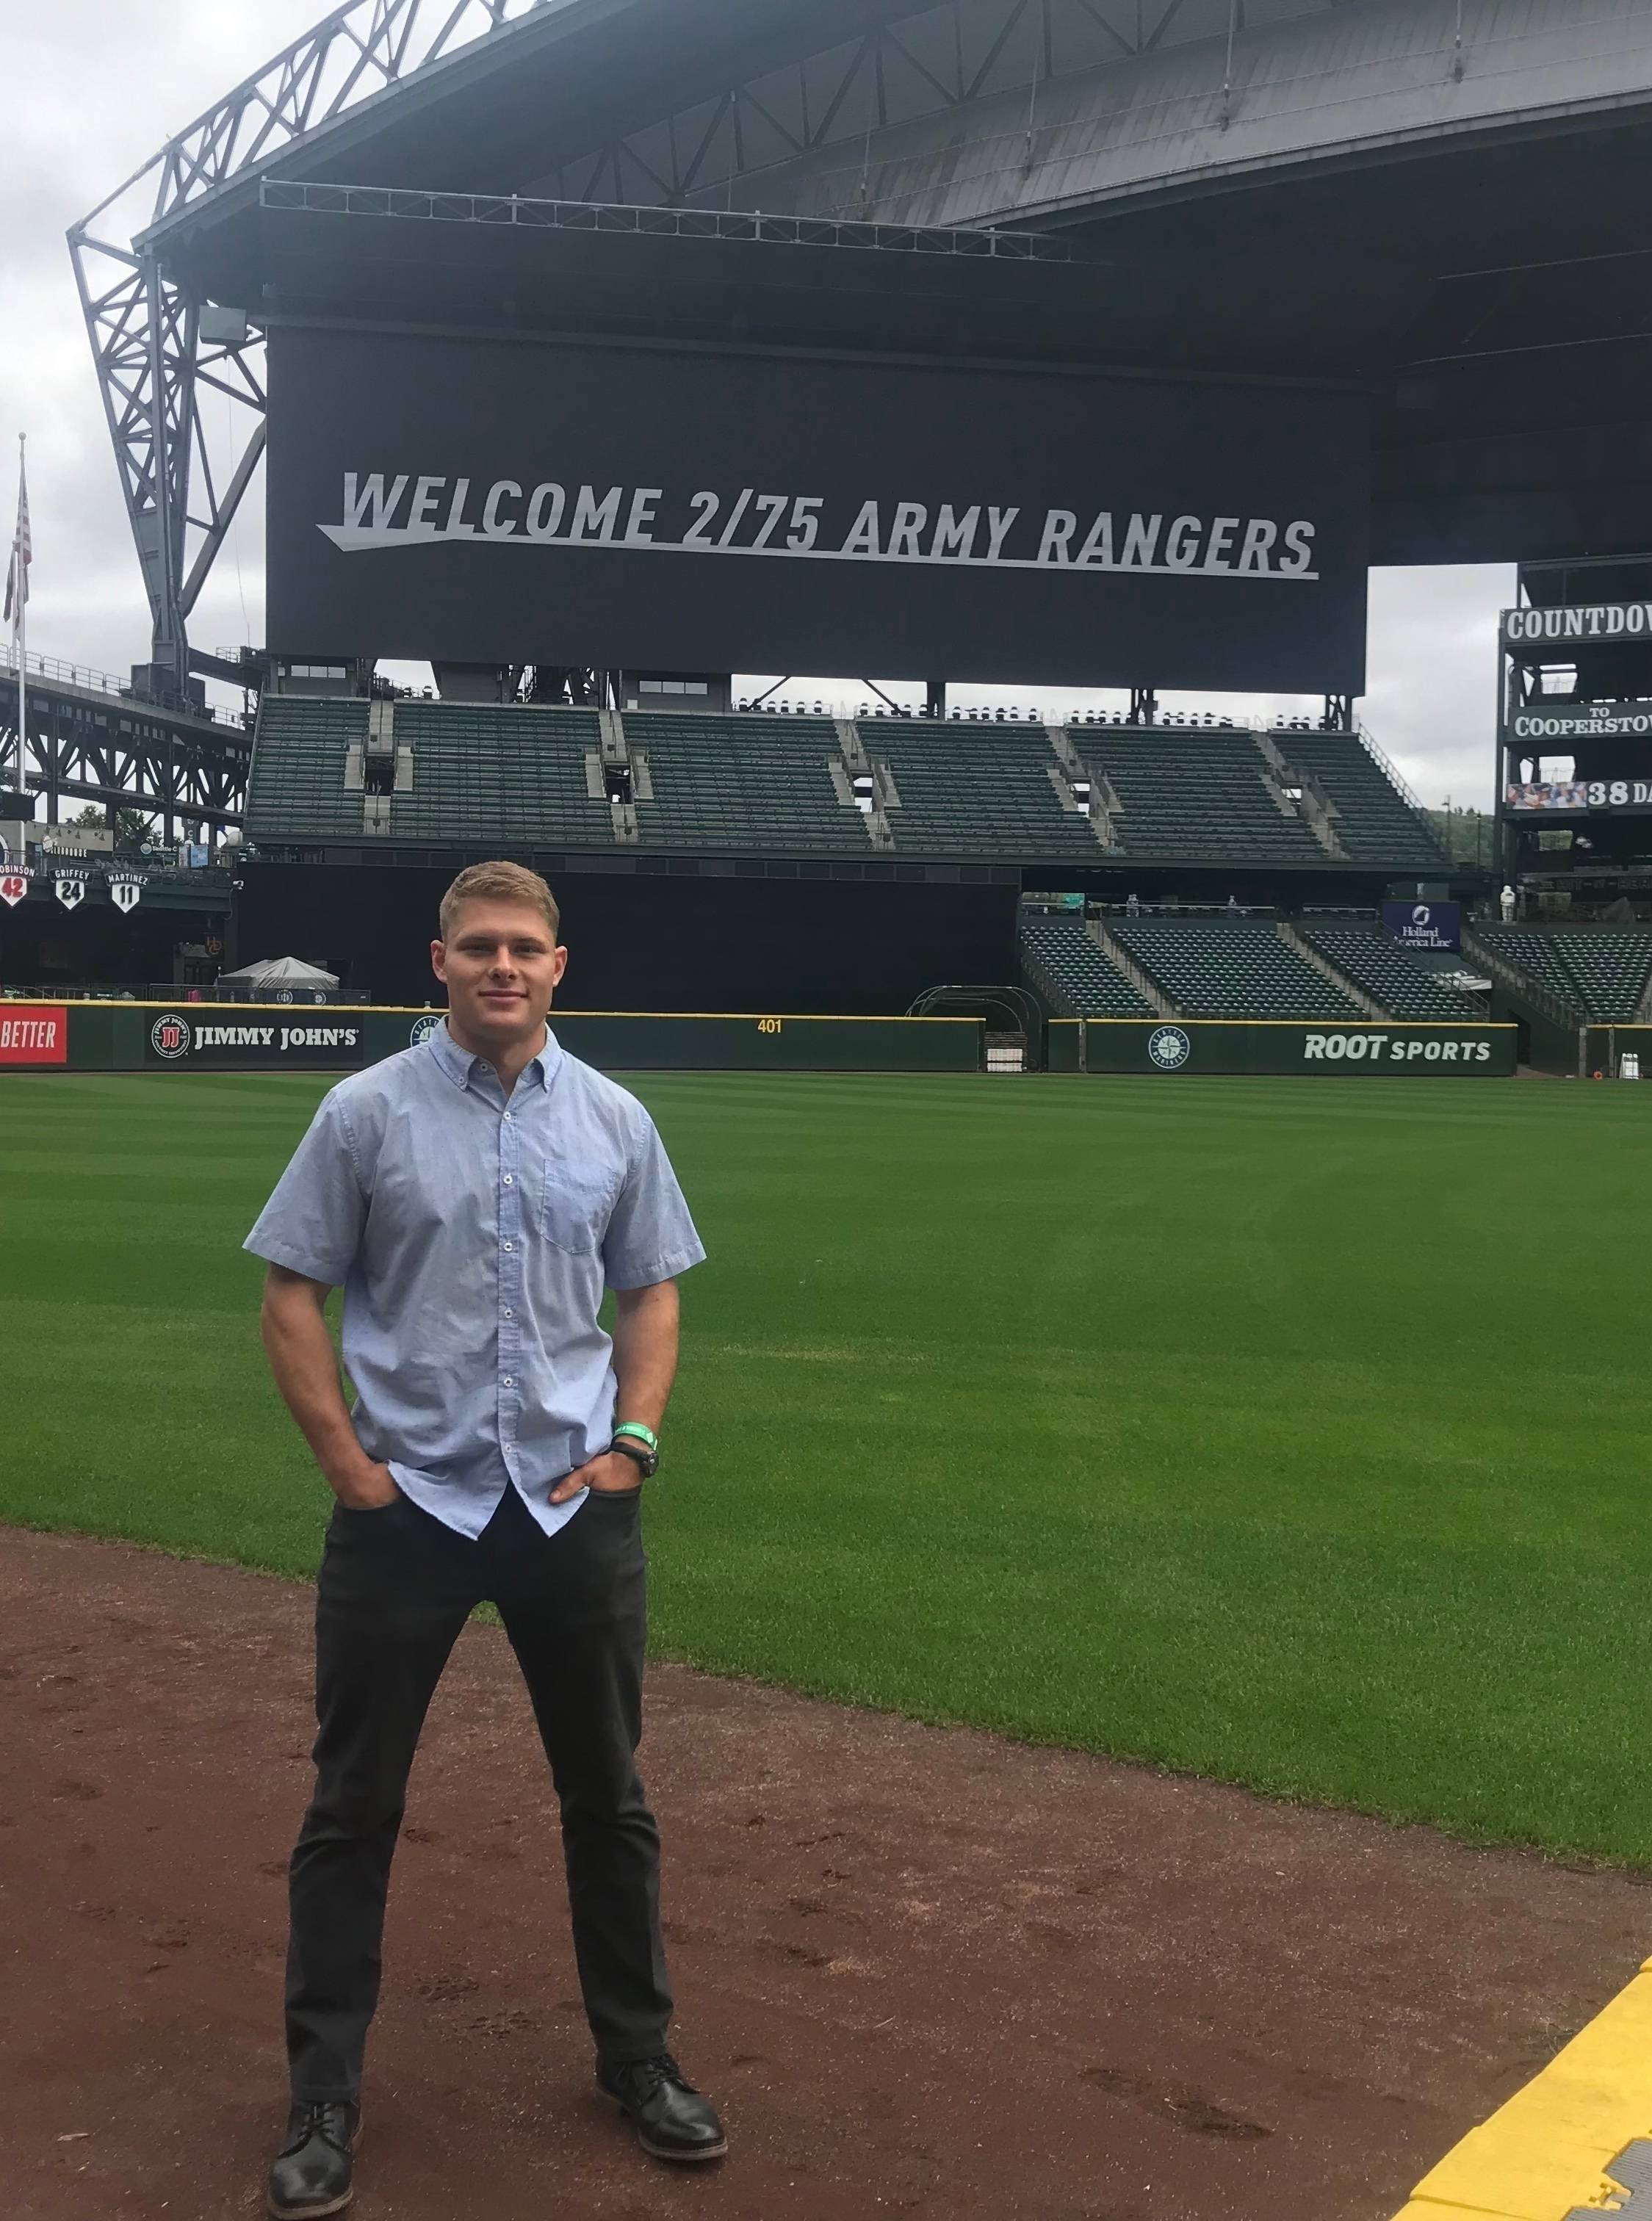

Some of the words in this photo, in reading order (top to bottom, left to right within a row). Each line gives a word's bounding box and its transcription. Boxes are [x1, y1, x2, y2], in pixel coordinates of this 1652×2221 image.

[344, 472, 663, 543] WELCOME
[682, 488, 824, 551] 2/75
[841, 500, 1020, 559] ARMY
[1037, 510, 1316, 573] RANGERS
[1589, 707, 1610, 718] TO
[1515, 715, 1652, 737] COOPERSTO
[1588, 781, 1628, 806] 38
[55, 869, 90, 881] GRIFFEY
[108, 873, 148, 886] MARTINEZ
[1, 877, 24, 898] 42
[61, 882, 81, 901] 24
[119, 886, 133, 904] 11
[1402, 926, 1439, 936] Holland
[1430, 937, 1451, 947] Line
[1, 1021, 57, 1048] BETTER
[758, 1019, 781, 1033] 401
[162, 1027, 180, 1048] JJ
[195, 1027, 274, 1050] JIMMY
[281, 1028, 357, 1050] JOHN'S
[1304, 1034, 1388, 1060] ROOT
[1390, 1041, 1491, 1061] SPORTS
